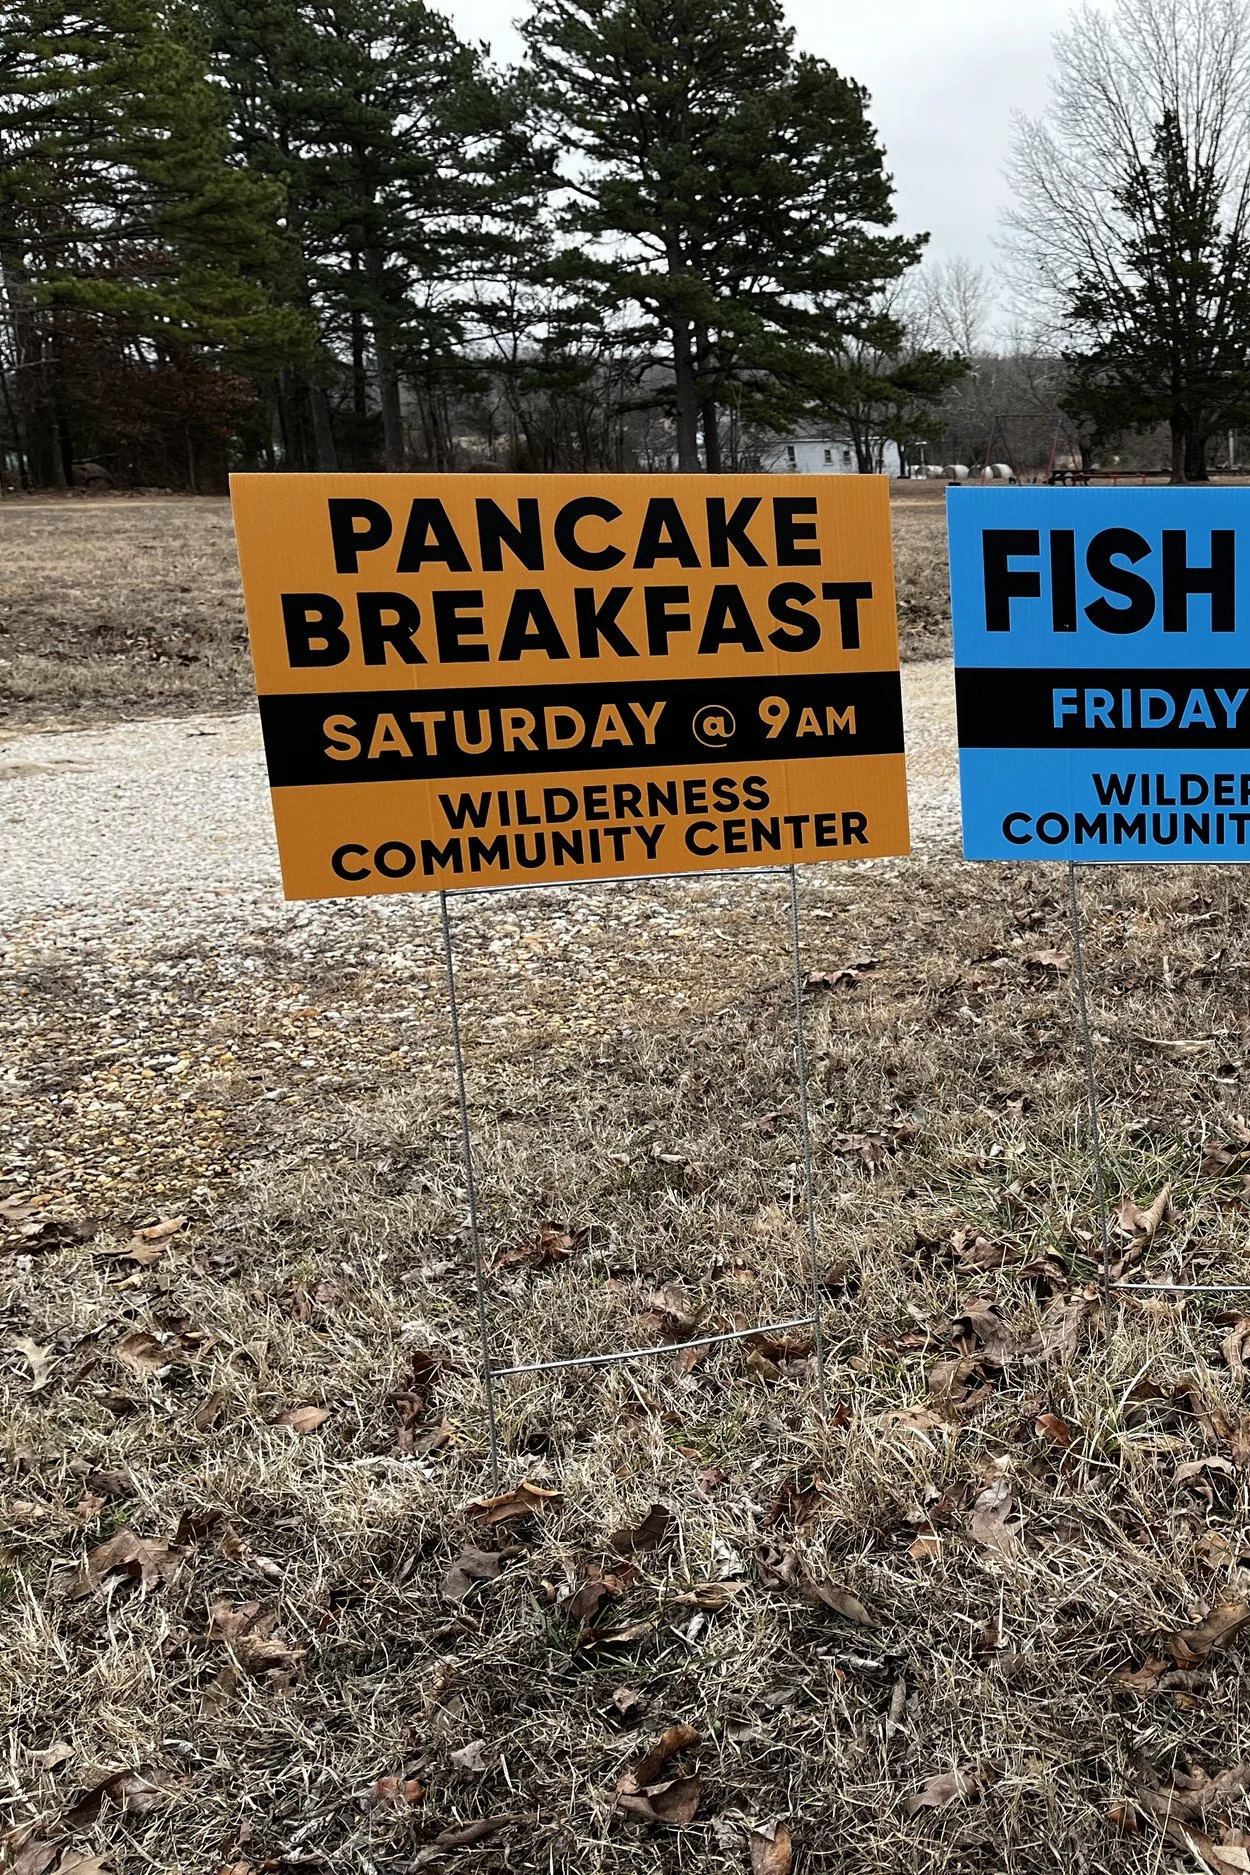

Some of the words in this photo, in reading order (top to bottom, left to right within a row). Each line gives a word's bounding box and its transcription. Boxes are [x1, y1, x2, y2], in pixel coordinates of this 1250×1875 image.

[327, 496, 822, 574] PANCAKE
[982, 527, 1236, 635] FISH
[280, 581, 873, 668] BREAKFAST
[322, 700, 667, 761] SATURDAY
[692, 704, 736, 747] @
[758, 695, 857, 739] 9AM
[1052, 688, 1249, 729] FRIDAY
[439, 775, 770, 830] WILDERNESS
[331, 824, 662, 881] COMMUNITY
[684, 810, 869, 856] CENTER
